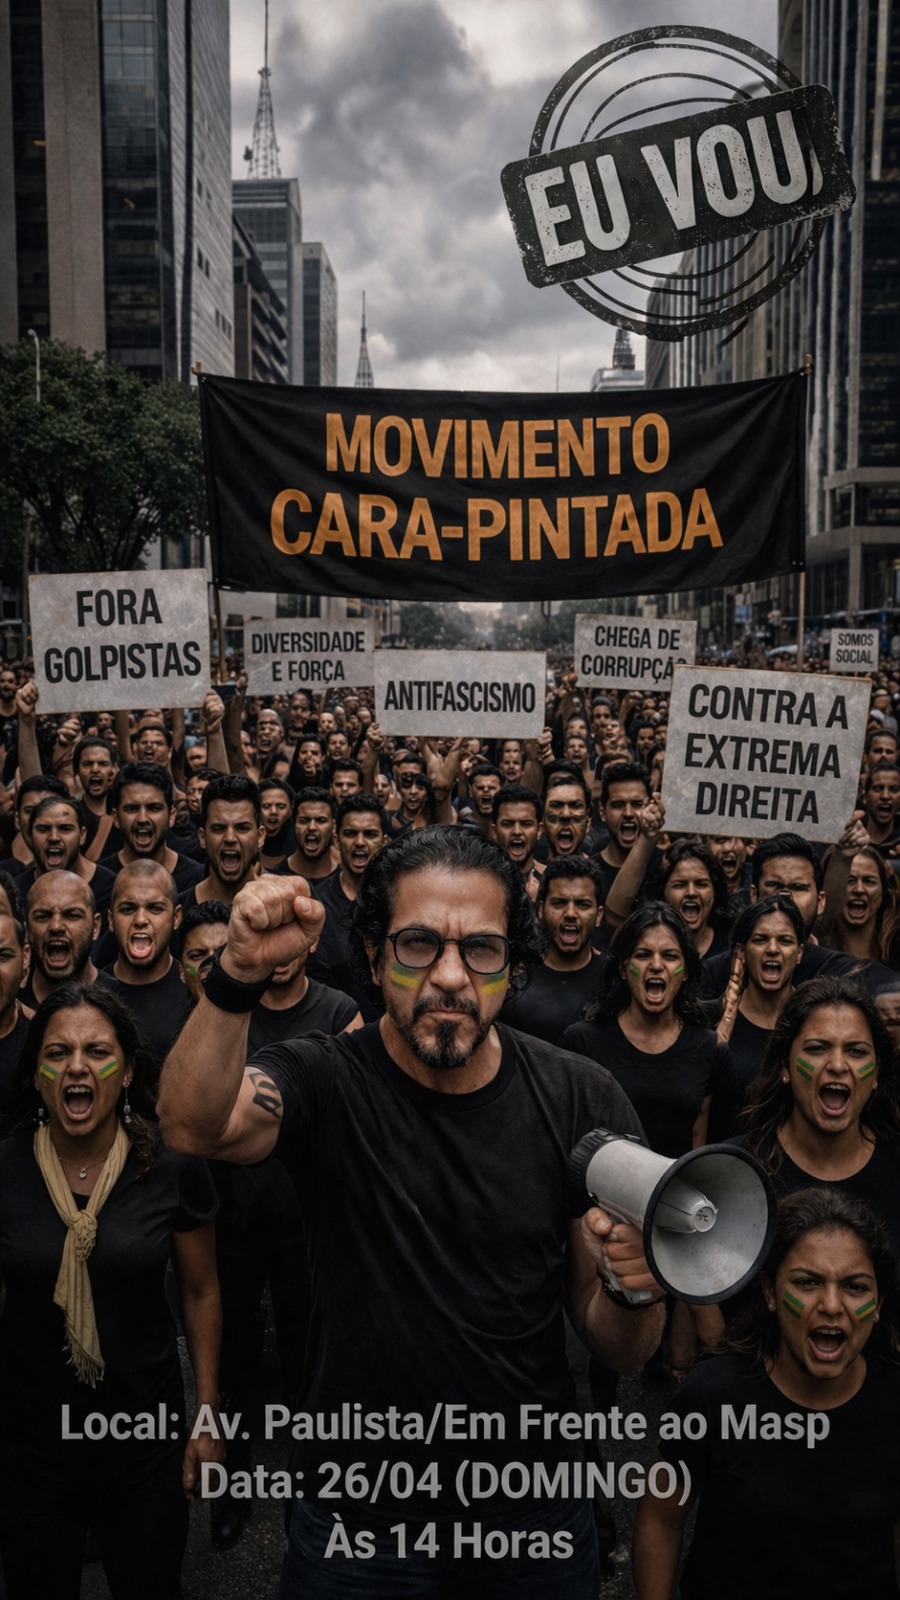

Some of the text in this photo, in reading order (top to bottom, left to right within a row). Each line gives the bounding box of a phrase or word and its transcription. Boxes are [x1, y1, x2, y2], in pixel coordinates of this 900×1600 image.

[325, 413, 670, 480] MOVIMENTO
[271, 488, 723, 561] CARA-PINTADA
[76, 588, 163, 627] FORA
[252, 631, 365, 654] DIVERSIDADE
[595, 626, 681, 650] CHEGA DE
[836, 649, 873, 664] SOCIAL
[838, 633, 874, 646] SOMOS
[44, 641, 201, 684] GOLPISTAS
[272, 660, 345, 684] E FORÇA
[384, 681, 536, 713] ANTIFASCISMO
[688, 683, 849, 730] CONTRA A
[684, 732, 841, 779] EXTREMA
[695, 781, 819, 824] DIREITA
